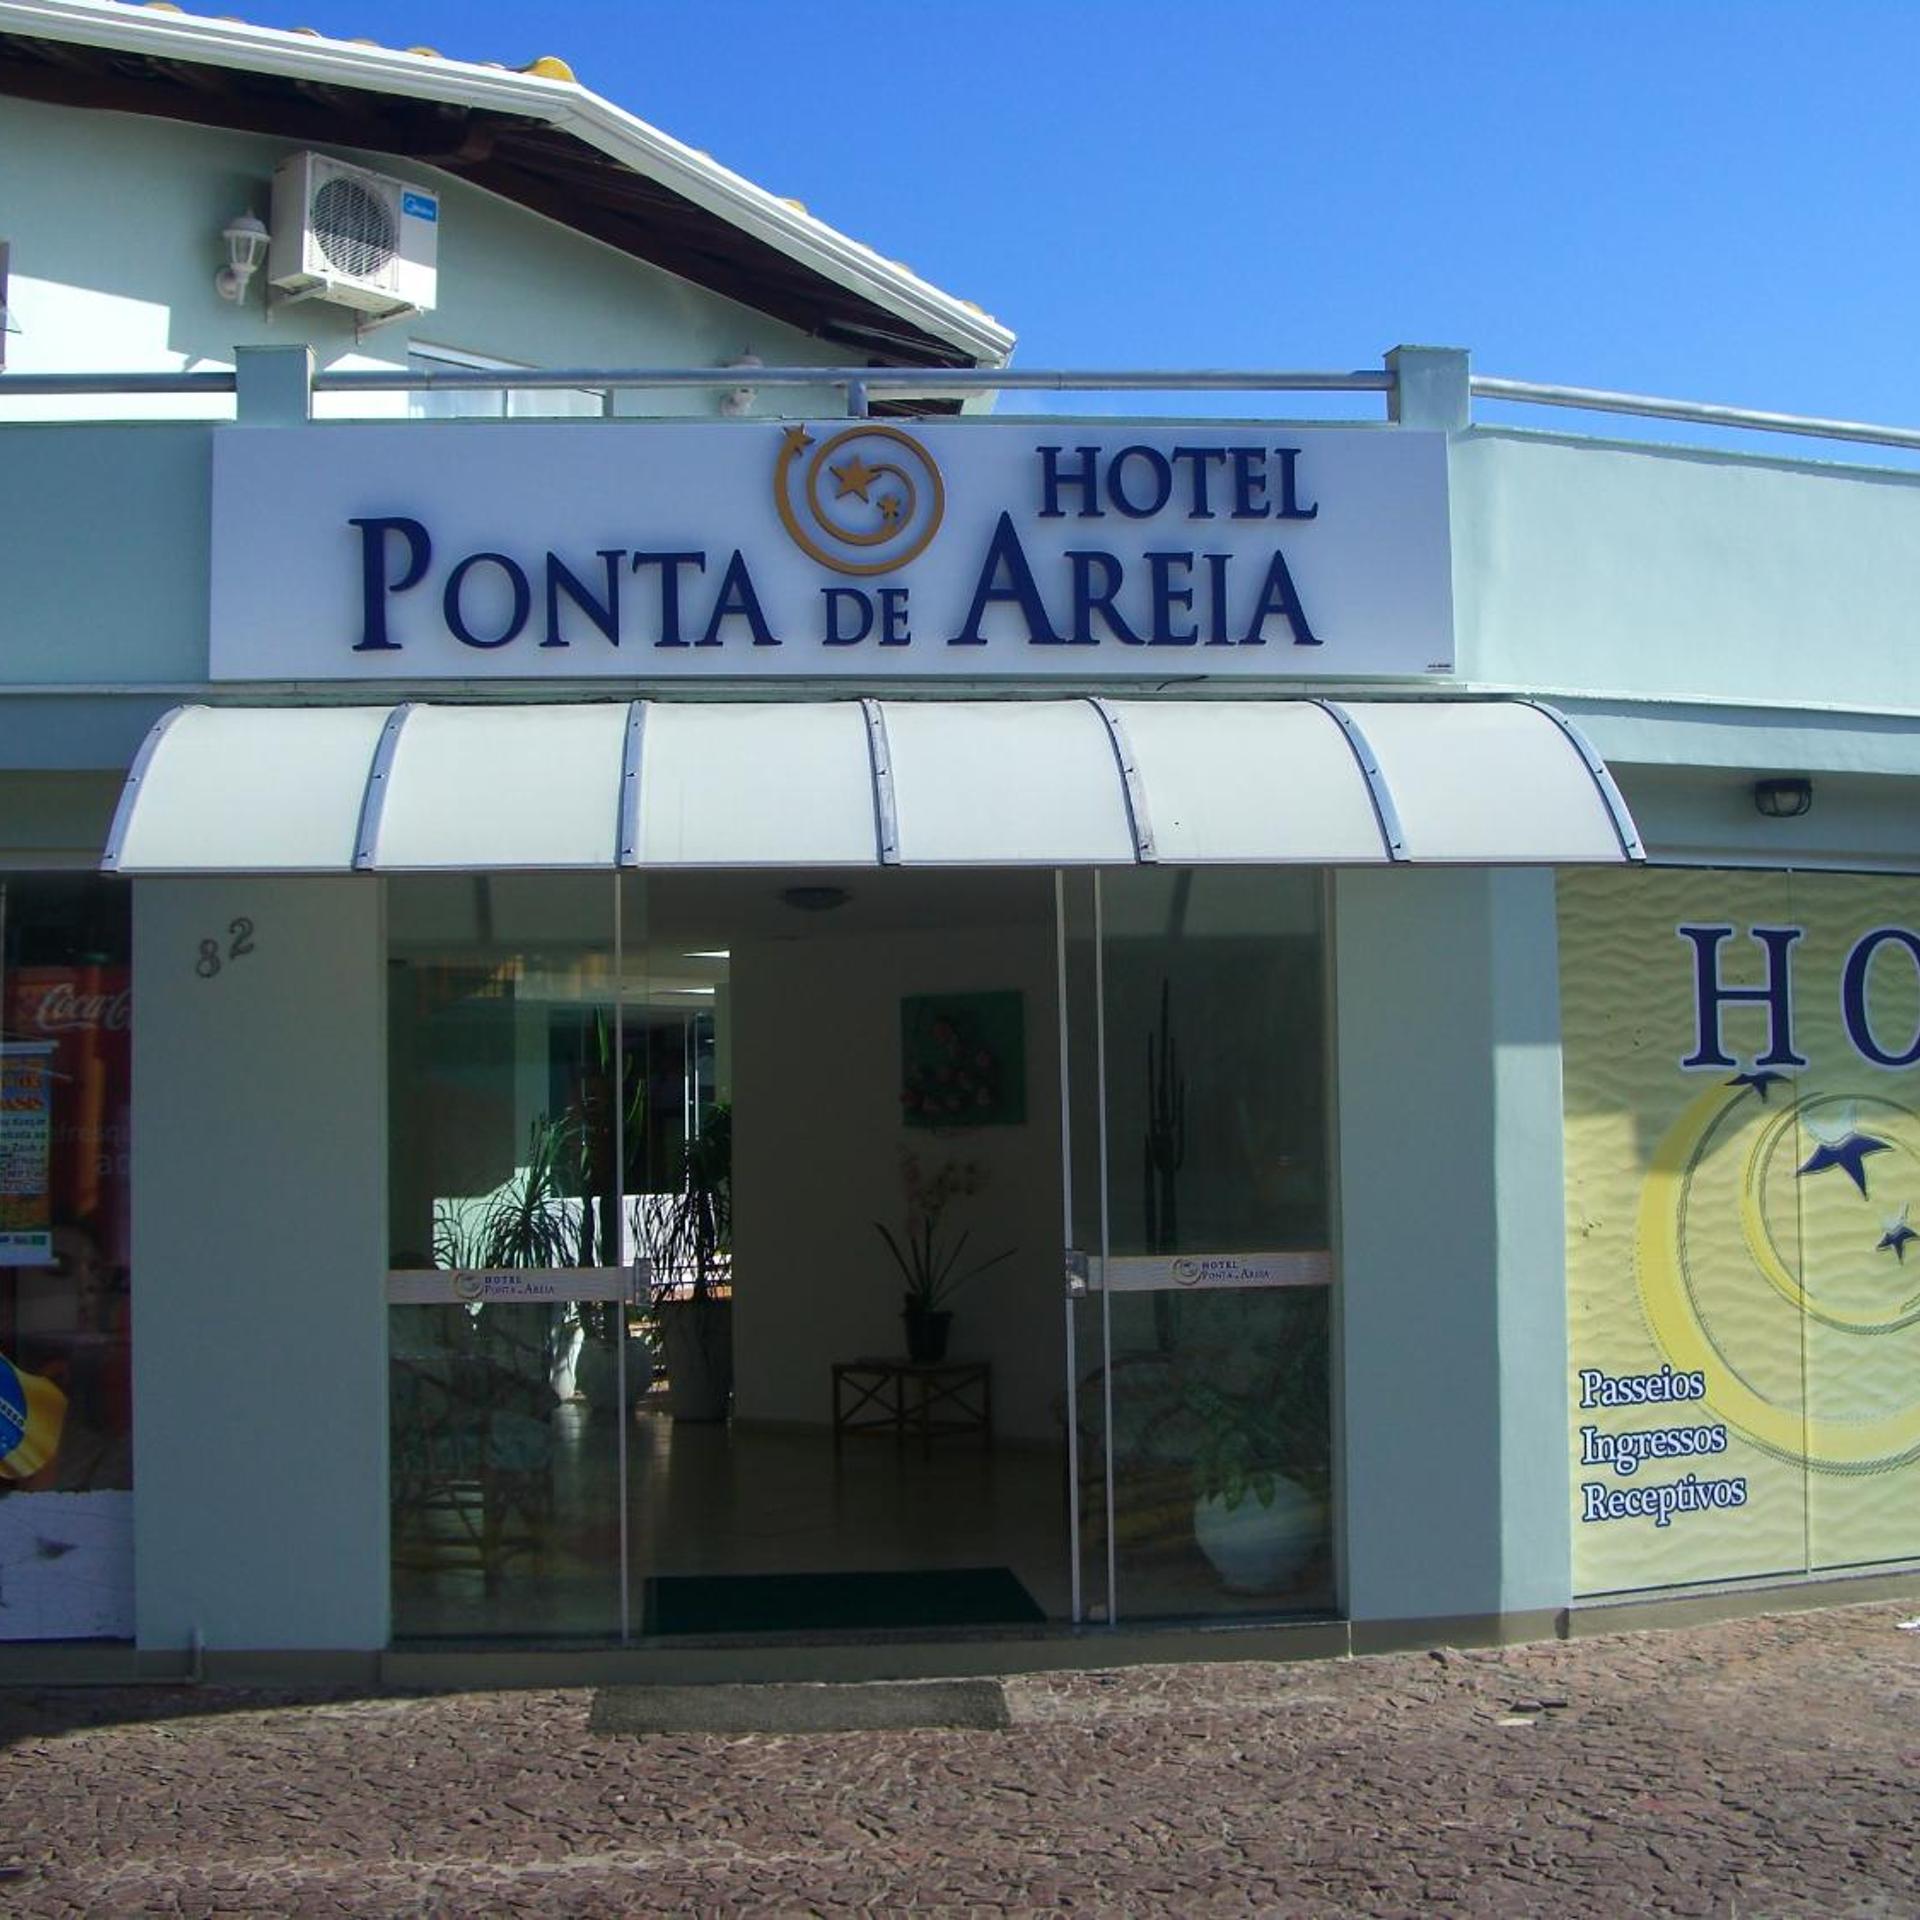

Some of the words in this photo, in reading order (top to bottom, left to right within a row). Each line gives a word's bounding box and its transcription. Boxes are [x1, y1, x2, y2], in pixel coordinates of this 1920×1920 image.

[1036, 446, 1318, 520] HOTEL
[348, 516, 782, 652] PONTA
[820, 587, 912, 647] DE
[946, 510, 1324, 647] AREIA
[1579, 1364, 1706, 1408] Passeios
[1580, 1424, 1727, 1475] Ingressos
[1582, 1474, 1747, 1526] Receptivos
